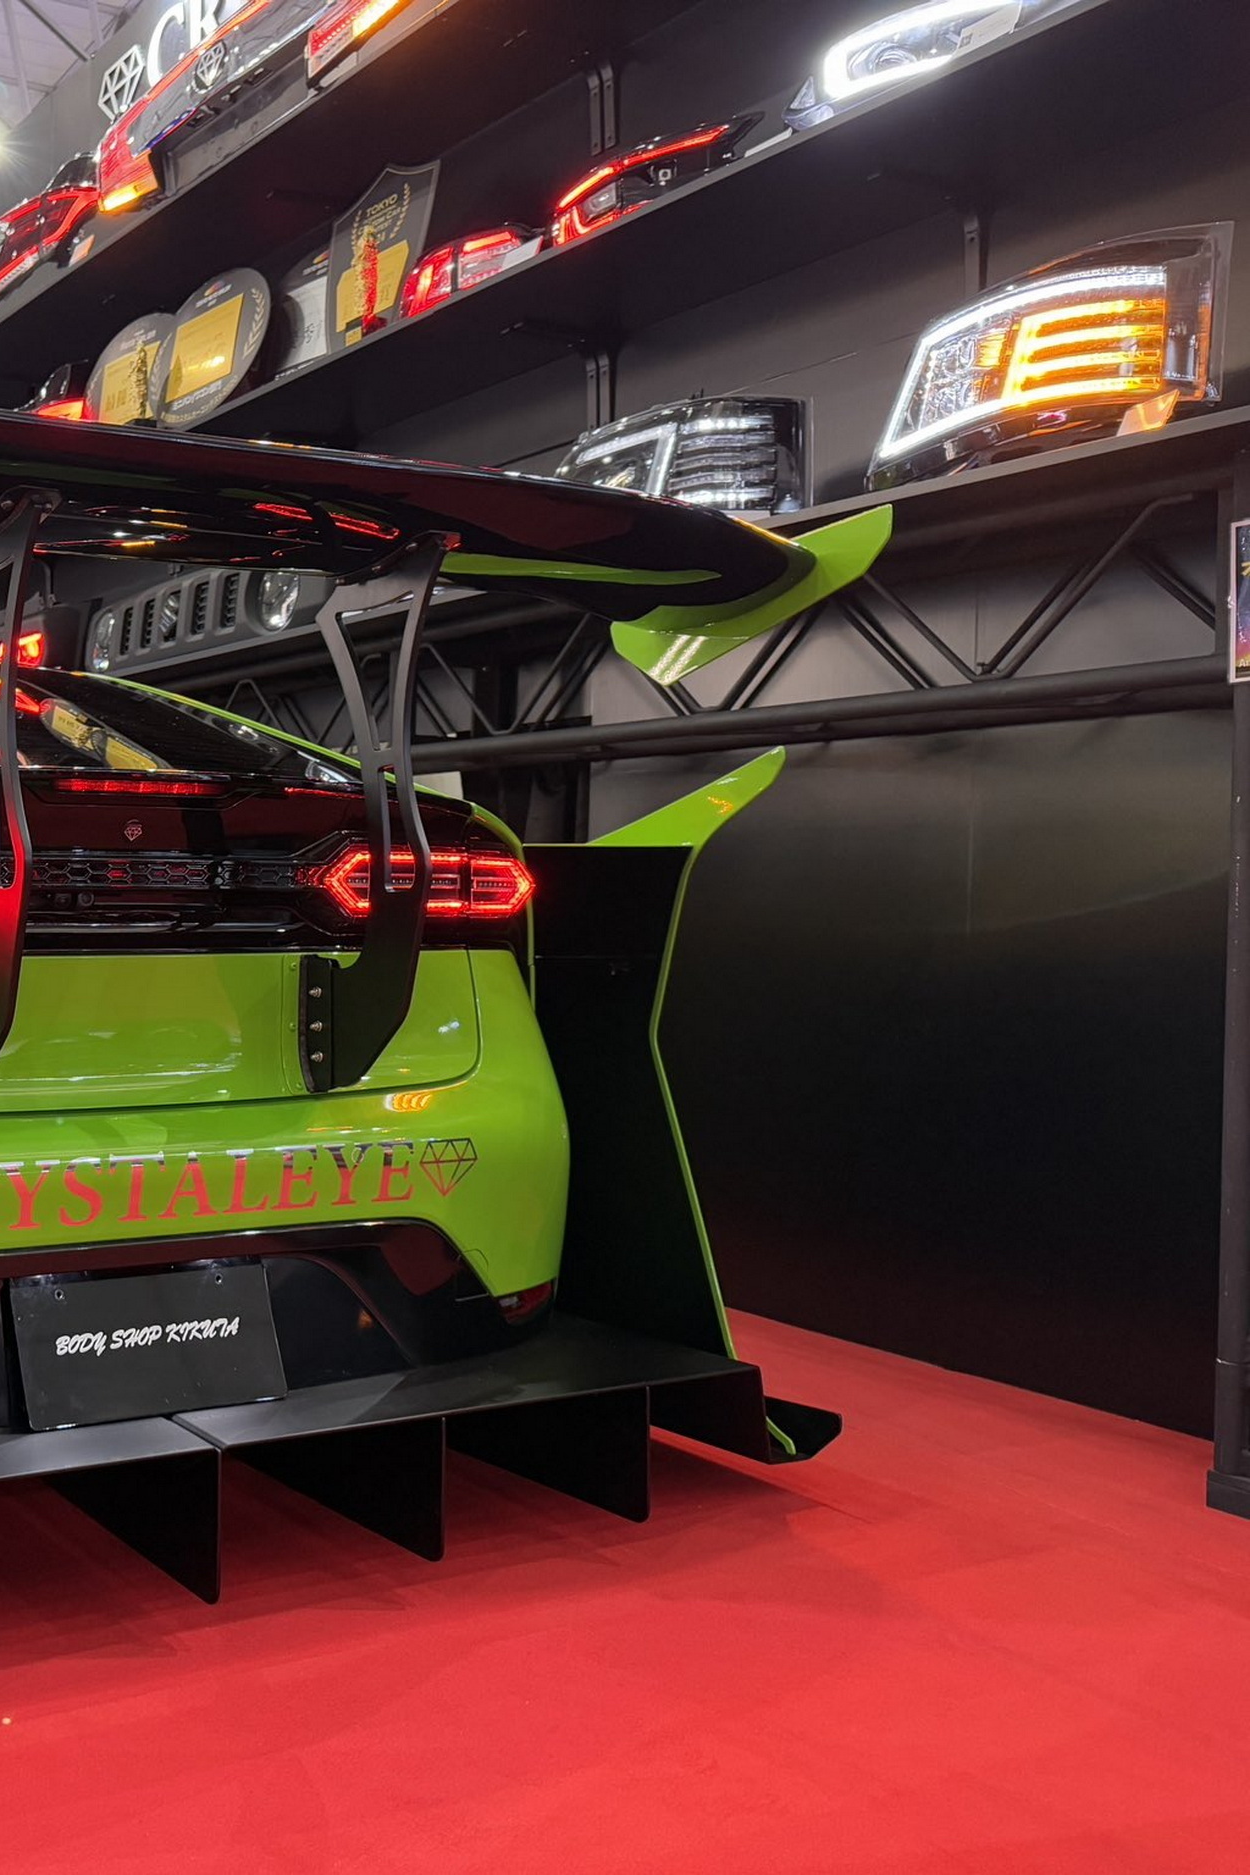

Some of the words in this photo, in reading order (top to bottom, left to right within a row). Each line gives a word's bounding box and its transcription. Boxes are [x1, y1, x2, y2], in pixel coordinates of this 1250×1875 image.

[366, 193, 398, 217] TOKYO
[55, 1331, 108, 1357] BODY
[109, 1324, 163, 1350] SHOP
[165, 1316, 240, 1343] KIKUTA
